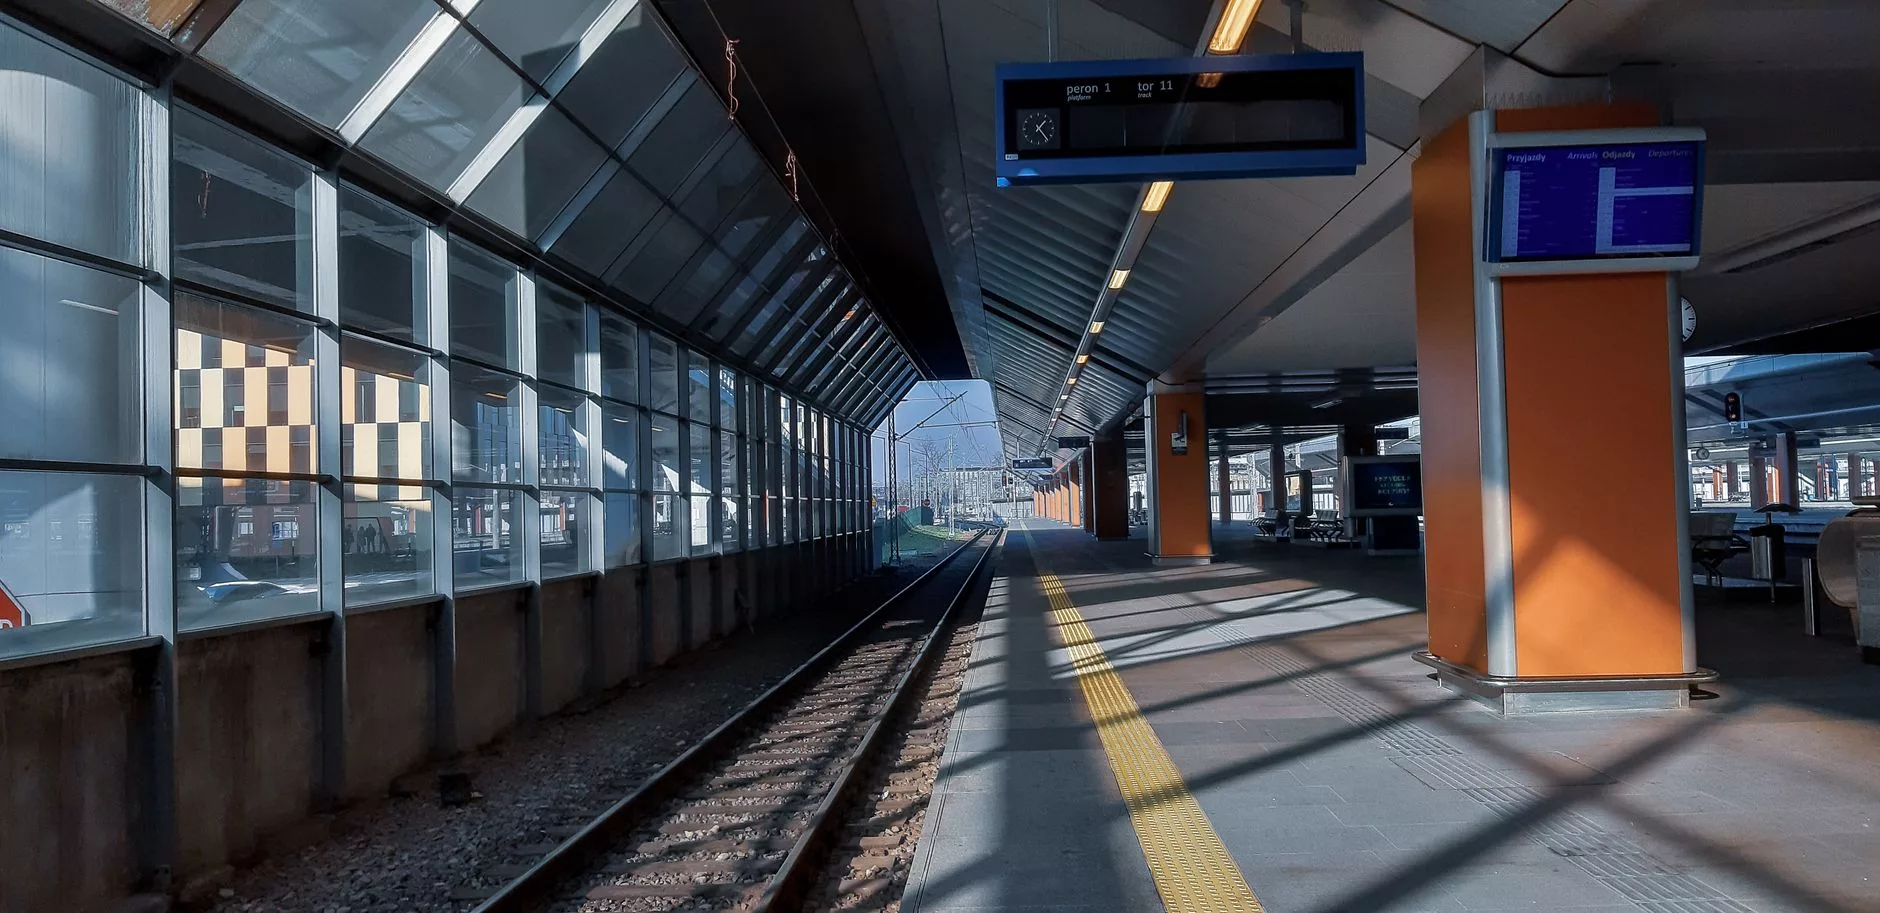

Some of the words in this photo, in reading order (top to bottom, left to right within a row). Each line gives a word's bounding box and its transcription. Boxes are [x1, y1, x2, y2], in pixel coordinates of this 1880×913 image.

[1066, 84, 1098, 95] peron
[1104, 82, 1111, 92] 1
[1138, 82, 1154, 91] tor
[1160, 80, 1173, 90] 11
[1507, 153, 1546, 163] Przyjazdy
[1567, 151, 1598, 160] Arrivals
[1602, 150, 1636, 160] Odjazdy
